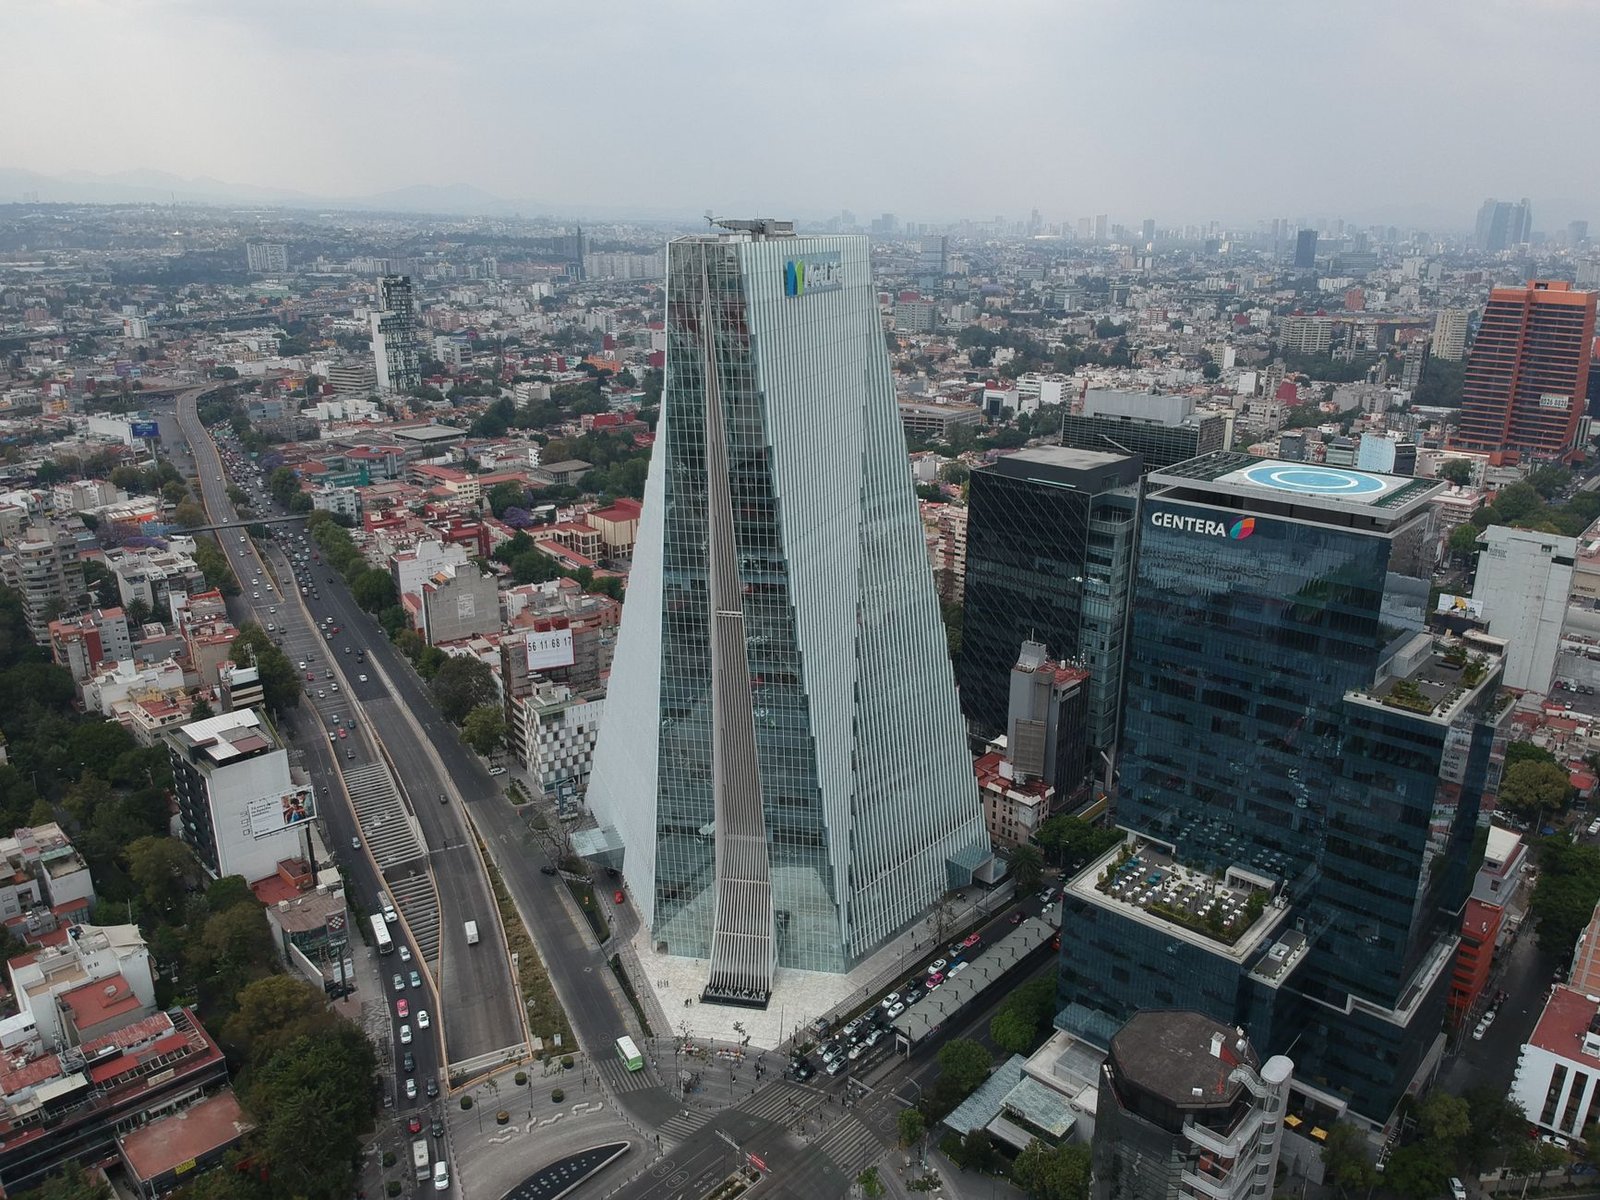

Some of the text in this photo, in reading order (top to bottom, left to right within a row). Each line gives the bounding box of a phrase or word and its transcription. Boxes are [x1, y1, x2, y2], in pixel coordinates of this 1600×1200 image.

[804, 262, 843, 288] MetLife
[1151, 512, 1226, 537] GENTERA
[528, 641, 537, 652] 56
[540, 640, 548, 650] 11
[564, 636, 572, 646] 17
[706, 987, 766, 1002] MANACAR
